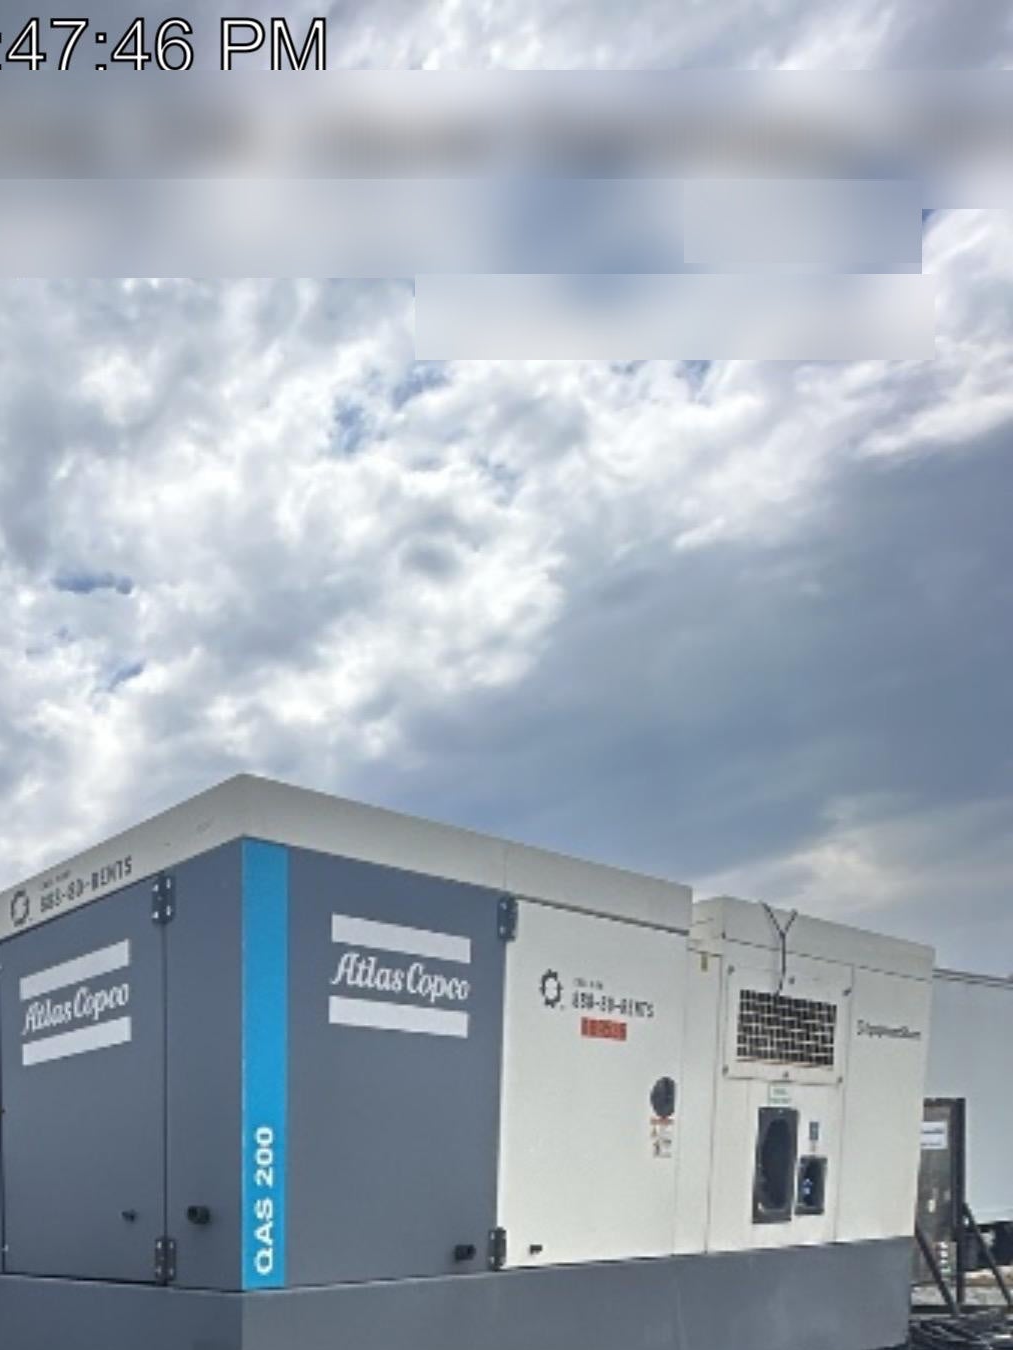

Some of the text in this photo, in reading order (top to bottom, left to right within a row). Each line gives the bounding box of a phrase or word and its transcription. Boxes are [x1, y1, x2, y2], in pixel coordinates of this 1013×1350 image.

[330, 951, 471, 1004] Atlas Copco
[22, 983, 130, 1036] Atlas Copco
[254, 1126, 275, 1276] QAS 200
